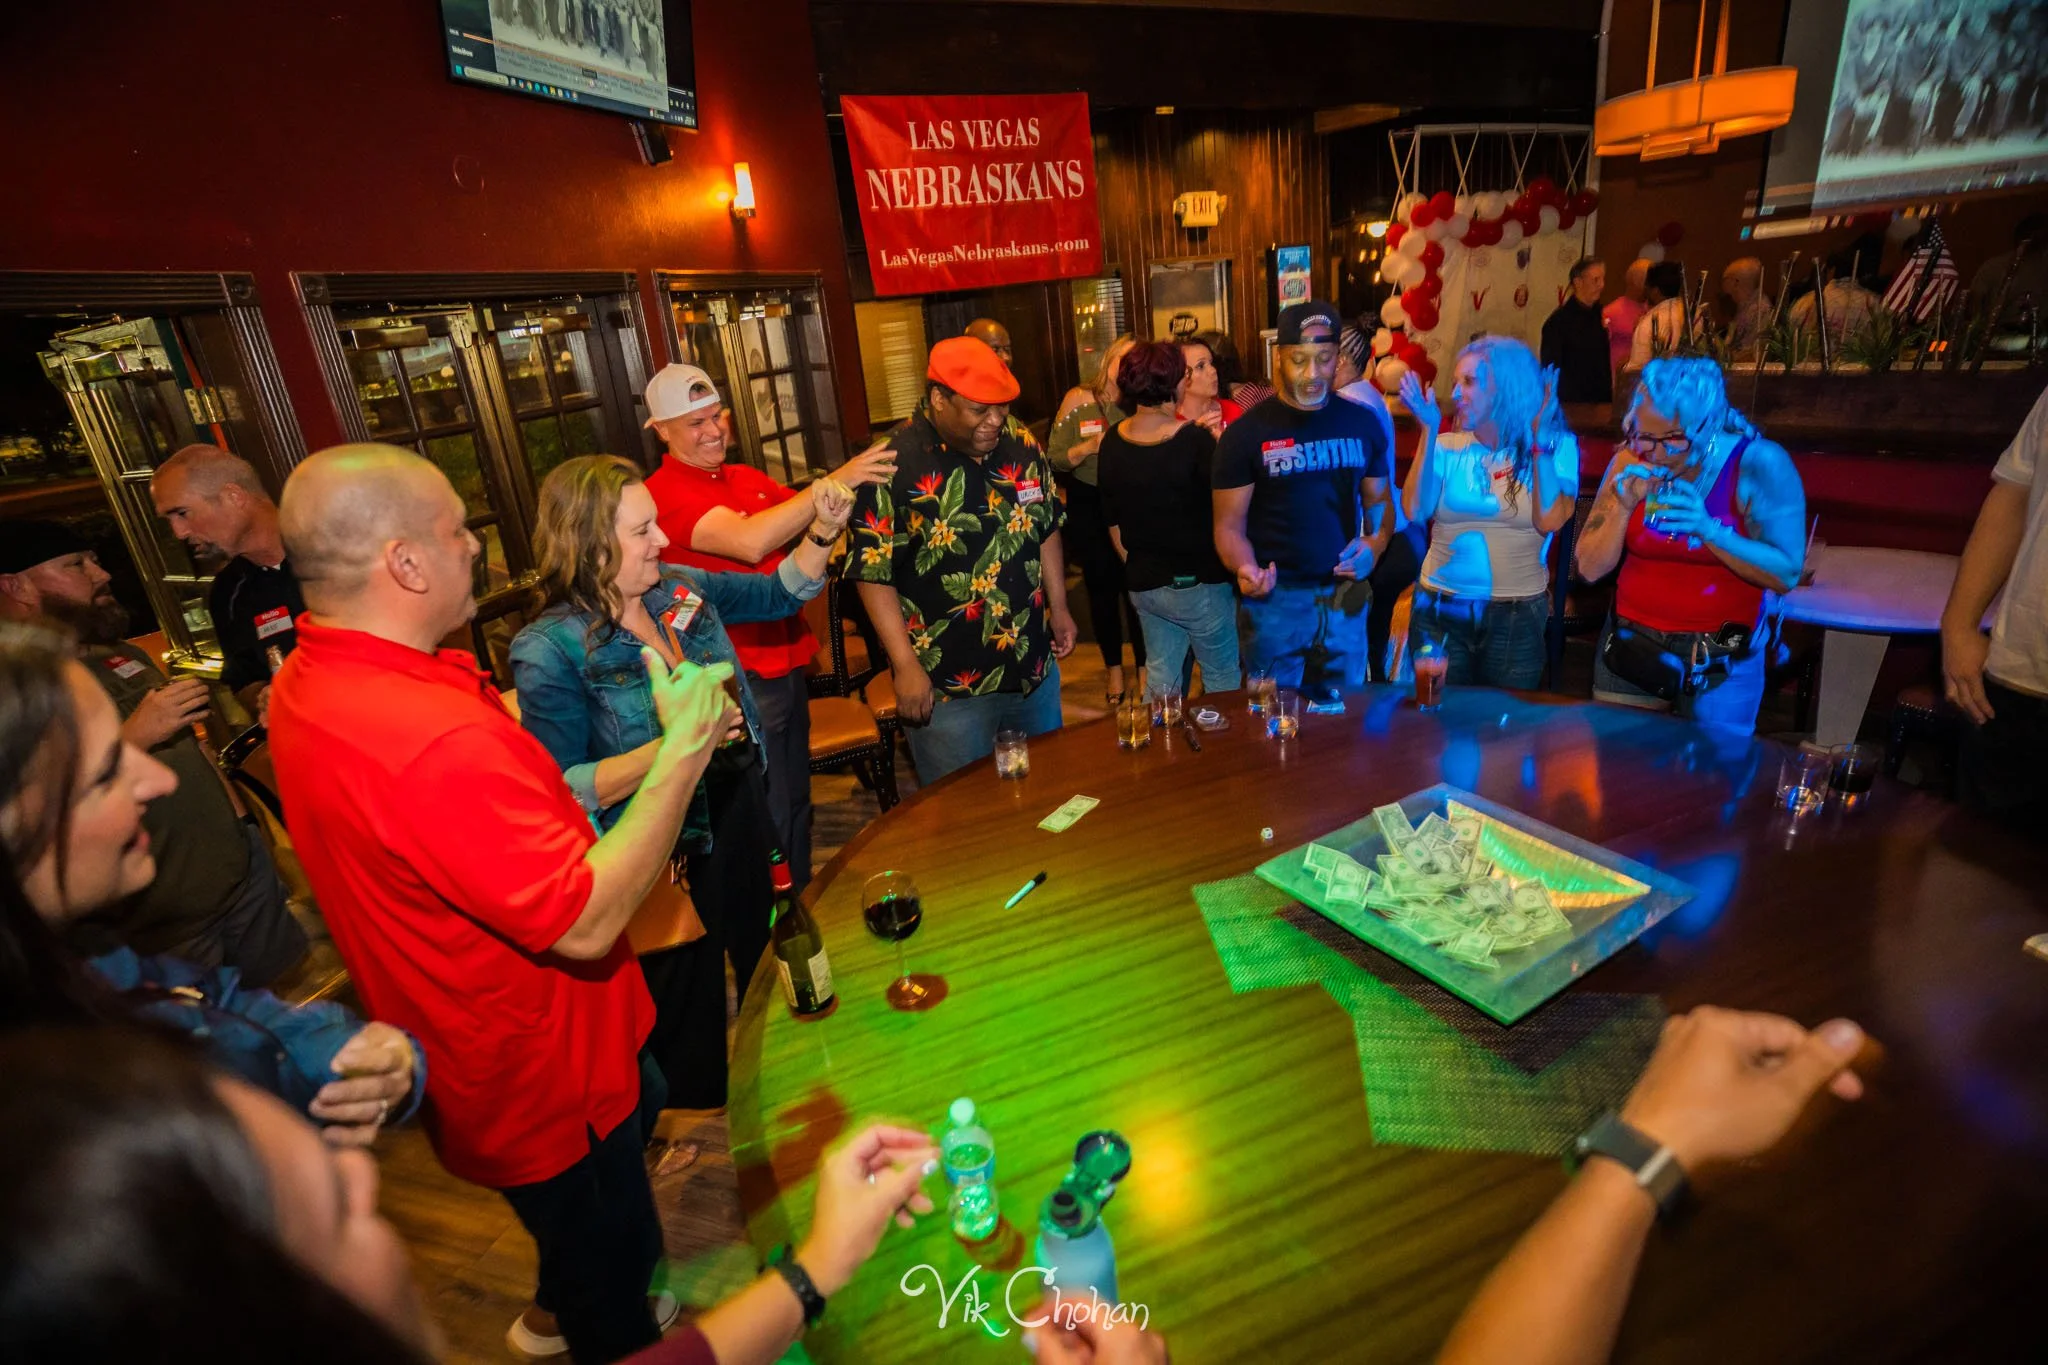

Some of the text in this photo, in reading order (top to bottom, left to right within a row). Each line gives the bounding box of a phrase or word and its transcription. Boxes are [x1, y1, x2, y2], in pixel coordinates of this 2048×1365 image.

[907, 117, 1041, 151] LAS VEGAS
[865, 159, 1085, 211] NEBRASKANS
[1192, 195, 1212, 216] EXIT
[881, 238, 1090, 269] LasVegasNebraskans.com
